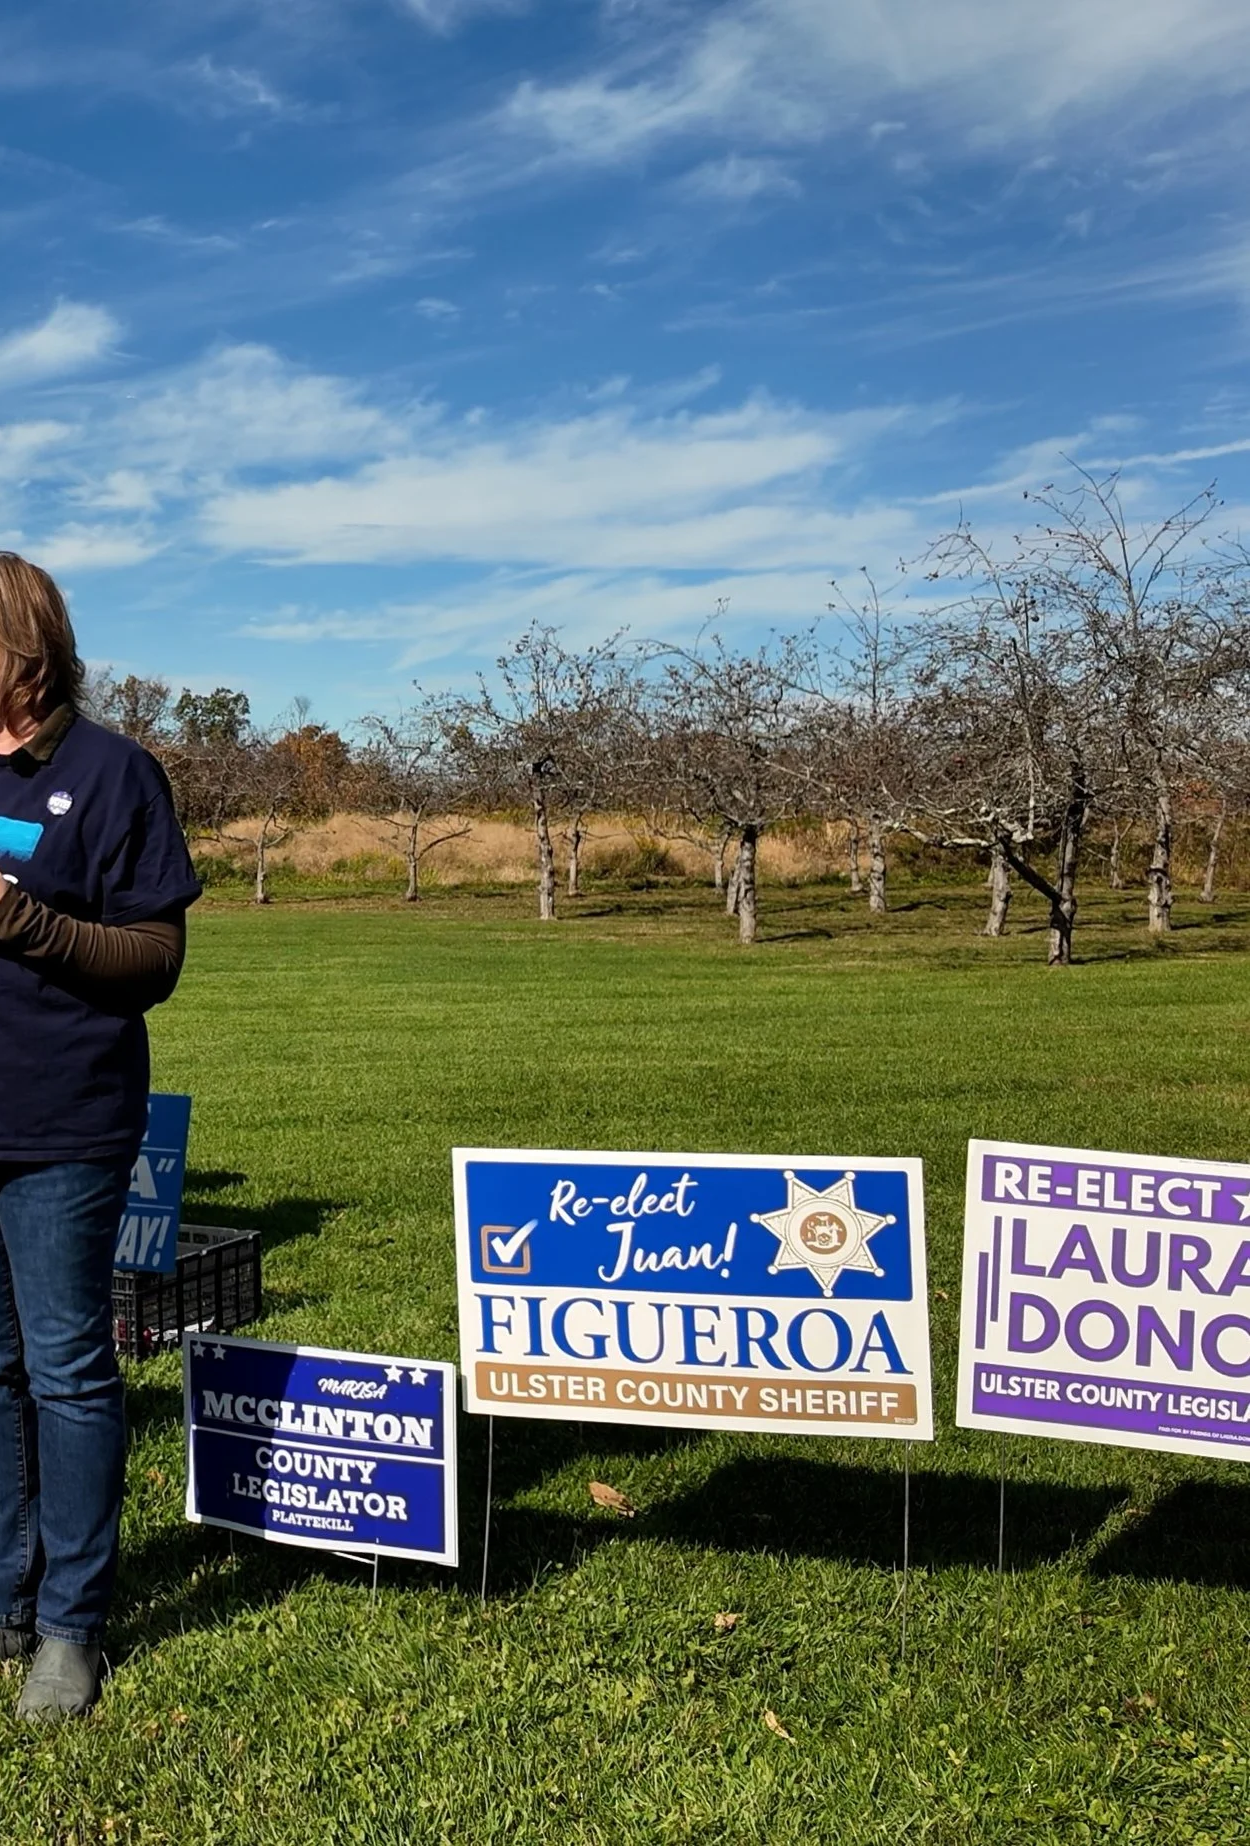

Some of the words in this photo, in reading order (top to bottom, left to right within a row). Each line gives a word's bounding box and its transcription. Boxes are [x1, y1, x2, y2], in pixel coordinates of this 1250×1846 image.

[548, 1172, 699, 1226] Re-elect
[994, 1161, 1222, 1219] RE-ELECT
[114, 1215, 171, 1268] AY!
[598, 1221, 738, 1283] Juan!
[1011, 1217, 1250, 1297] LAURA
[474, 1292, 915, 1376] FIGUEROA
[1007, 1291, 1250, 1379] DONO
[318, 1378, 389, 1400] MARISA
[488, 1370, 607, 1402] ULSTER
[615, 1379, 750, 1411] COUNTY
[758, 1387, 899, 1417] SHERIFF
[980, 1371, 1061, 1402] ULSTER
[1065, 1381, 1164, 1413] COUNTY
[202, 1390, 433, 1448] MCCLINTON
[255, 1446, 377, 1485] COUNTY
[232, 1472, 408, 1521] LEGISLATOR
[272, 1509, 354, 1532] PLATTEKILL
